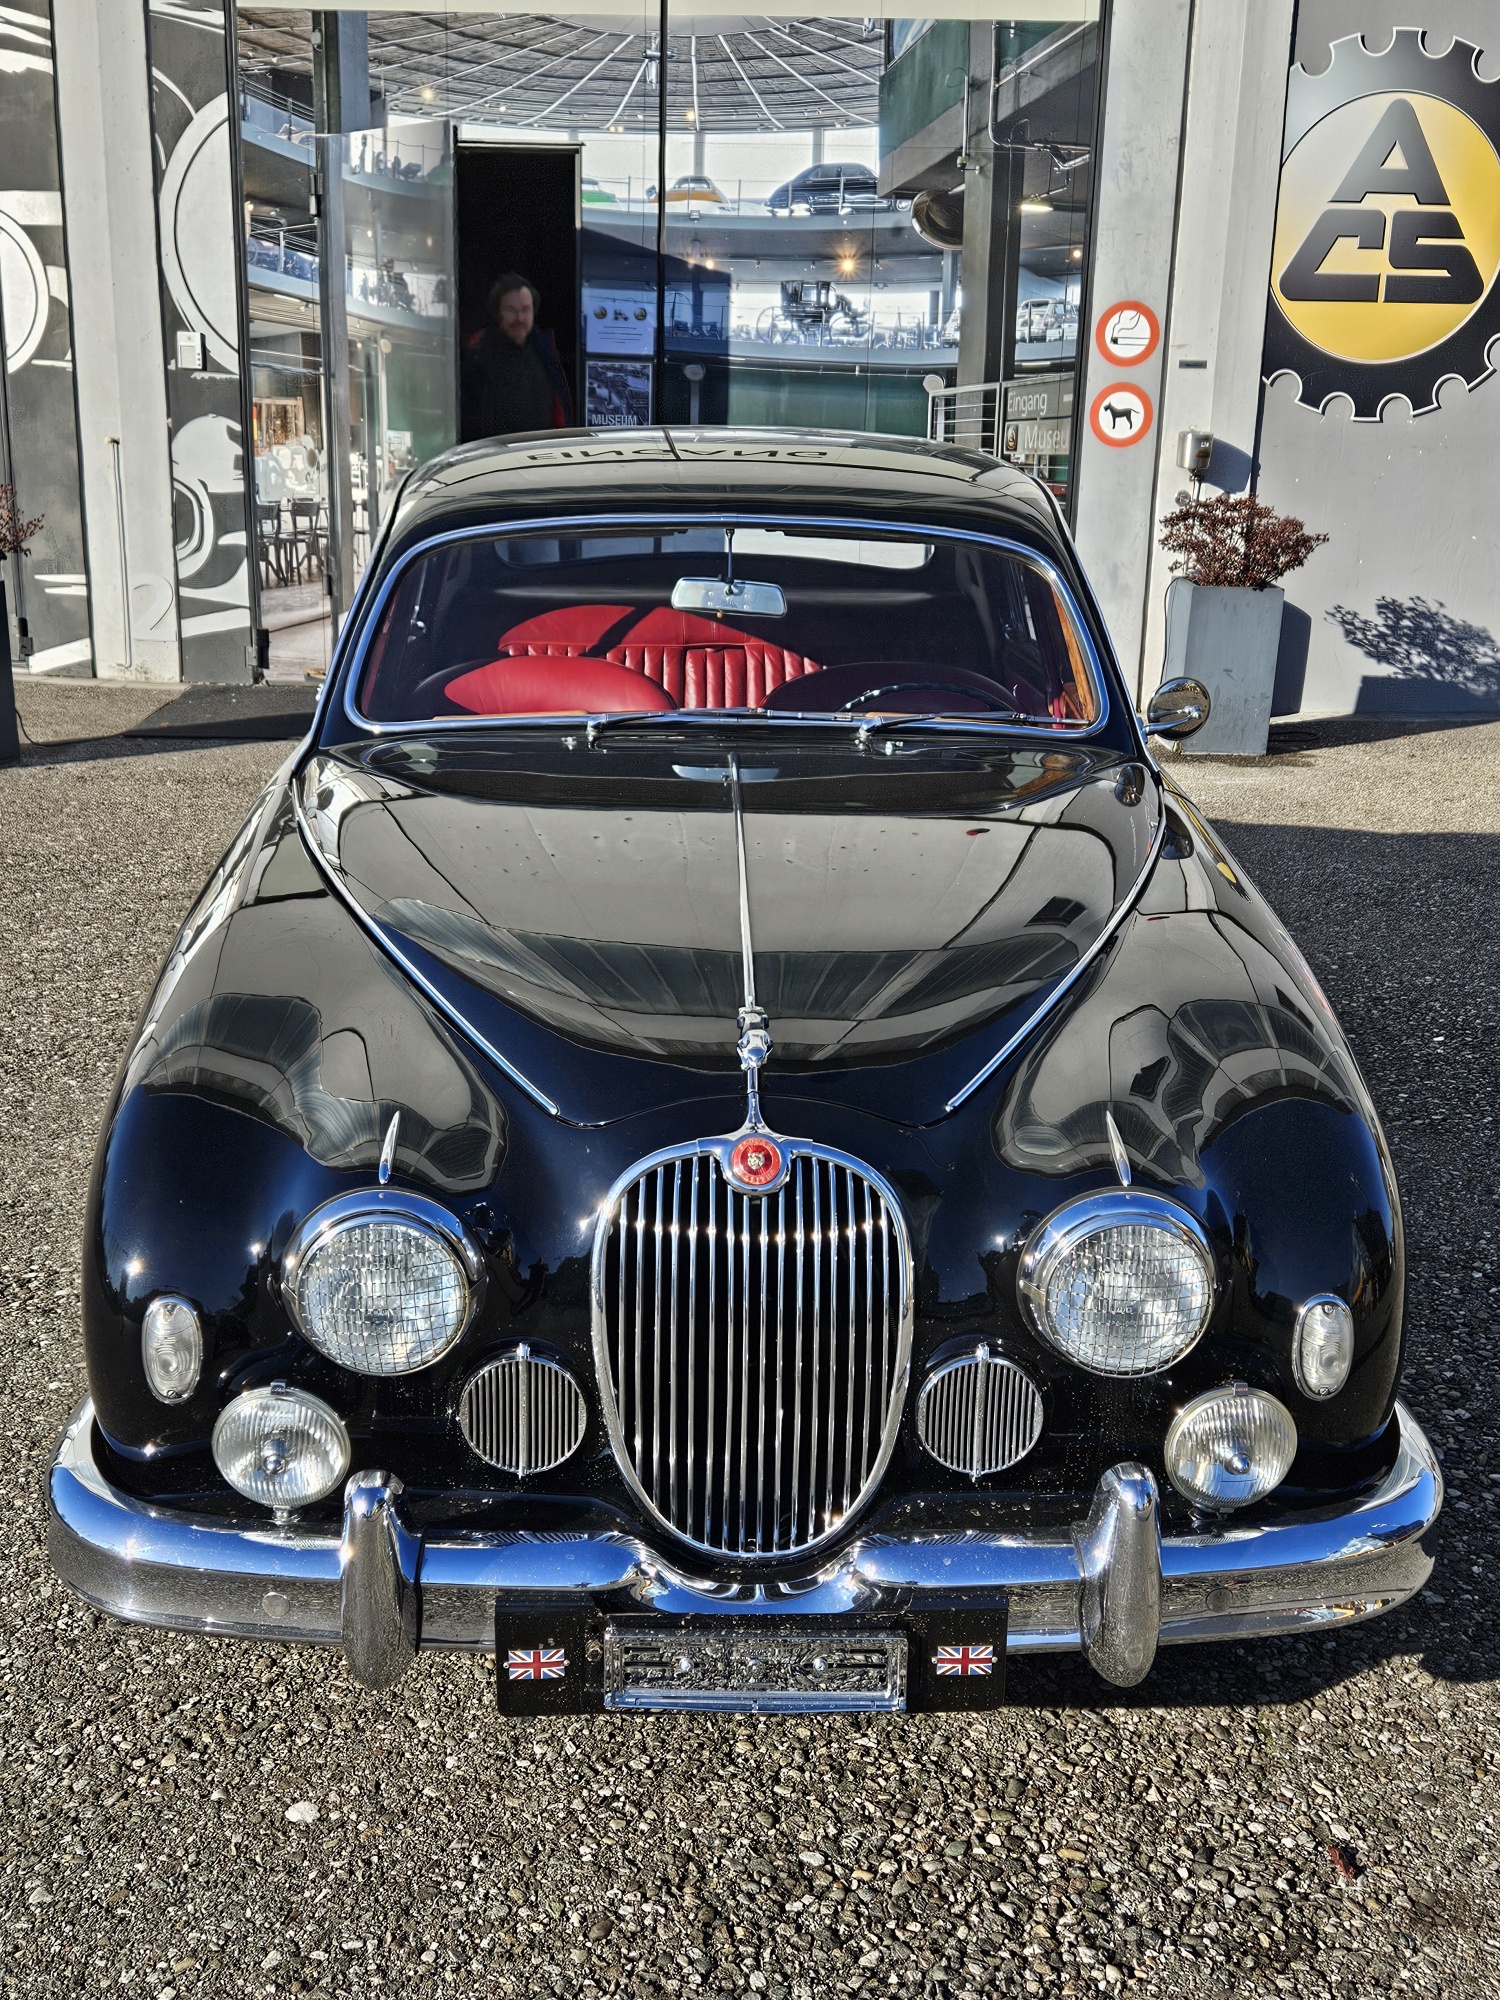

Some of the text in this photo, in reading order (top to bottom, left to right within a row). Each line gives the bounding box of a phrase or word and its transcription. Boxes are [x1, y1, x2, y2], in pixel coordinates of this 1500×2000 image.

[1007, 391, 1048, 416] Eingang
[591, 414, 637, 426] MUSEUM
[1024, 424, 1069, 449] Museu
